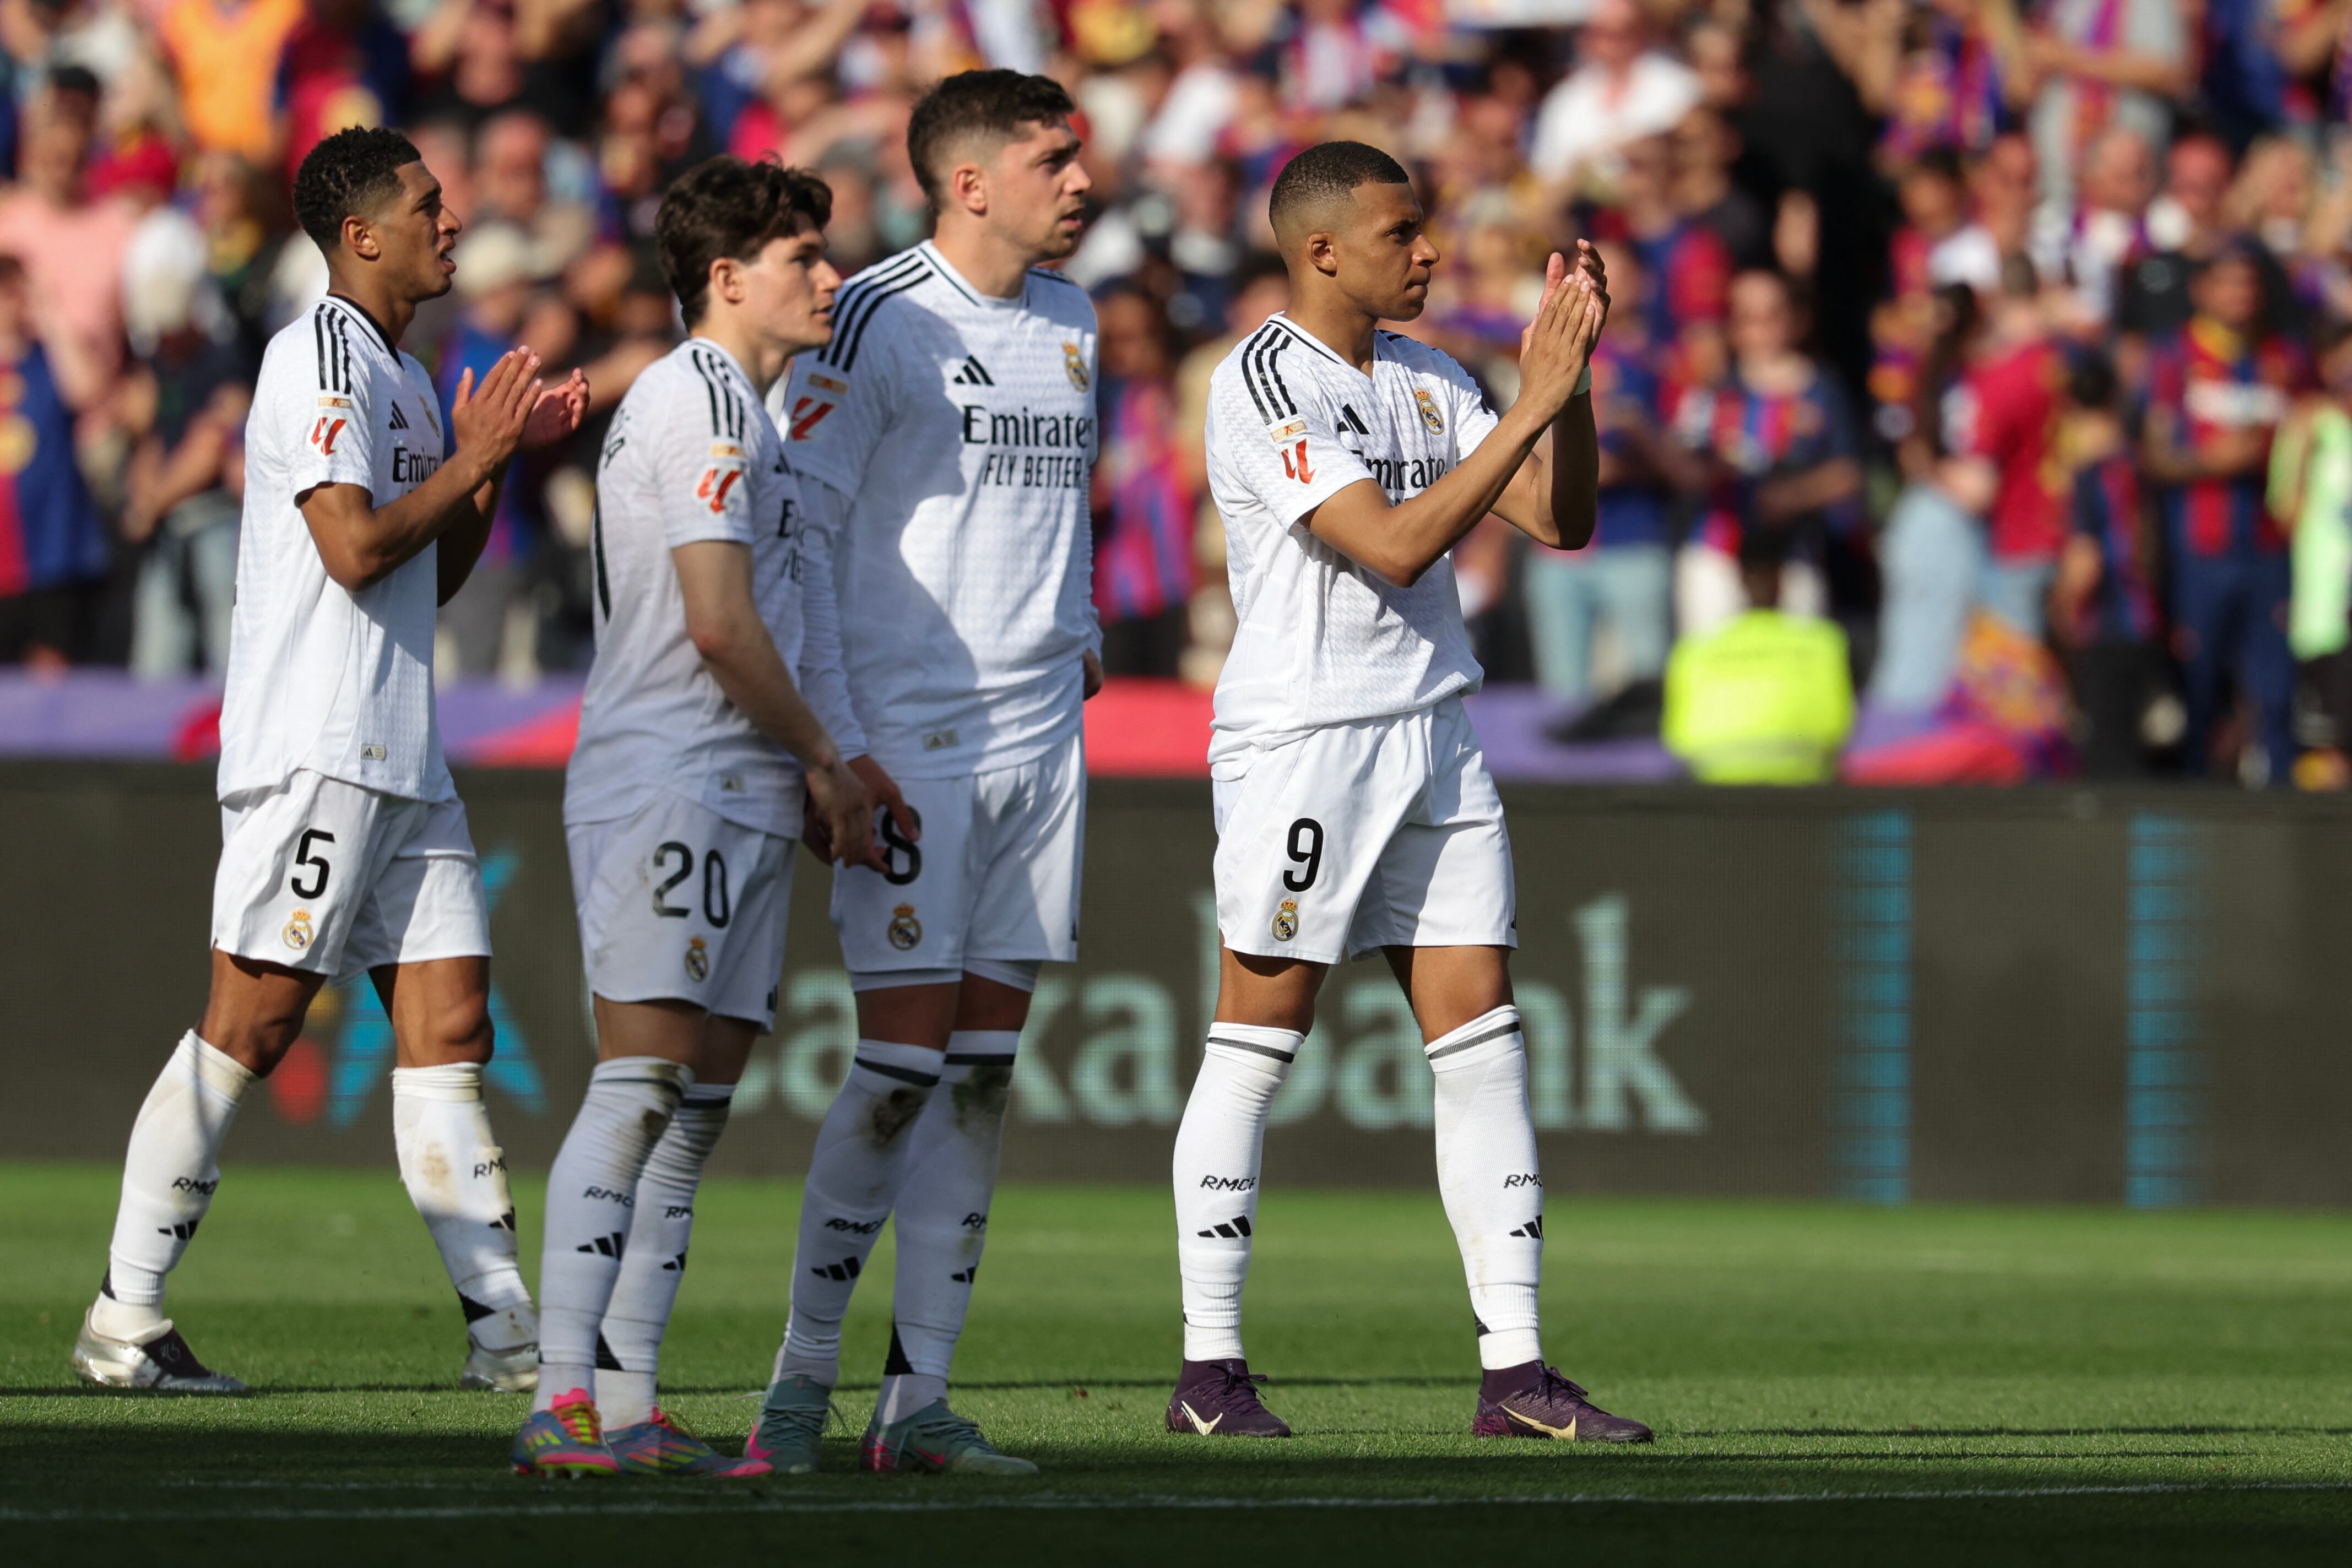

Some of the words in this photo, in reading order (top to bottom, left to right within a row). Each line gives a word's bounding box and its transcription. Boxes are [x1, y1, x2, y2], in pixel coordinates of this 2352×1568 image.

[984, 453, 1017, 486] FLY
[1023, 455, 1083, 489] BETTER
[1350, 449, 1448, 491] mirate
[291, 828, 335, 900] 5
[882, 805, 922, 885] 8
[1283, 818, 1324, 892] 9
[652, 841, 730, 929] 20
[1503, 1173, 1542, 1189] RM
